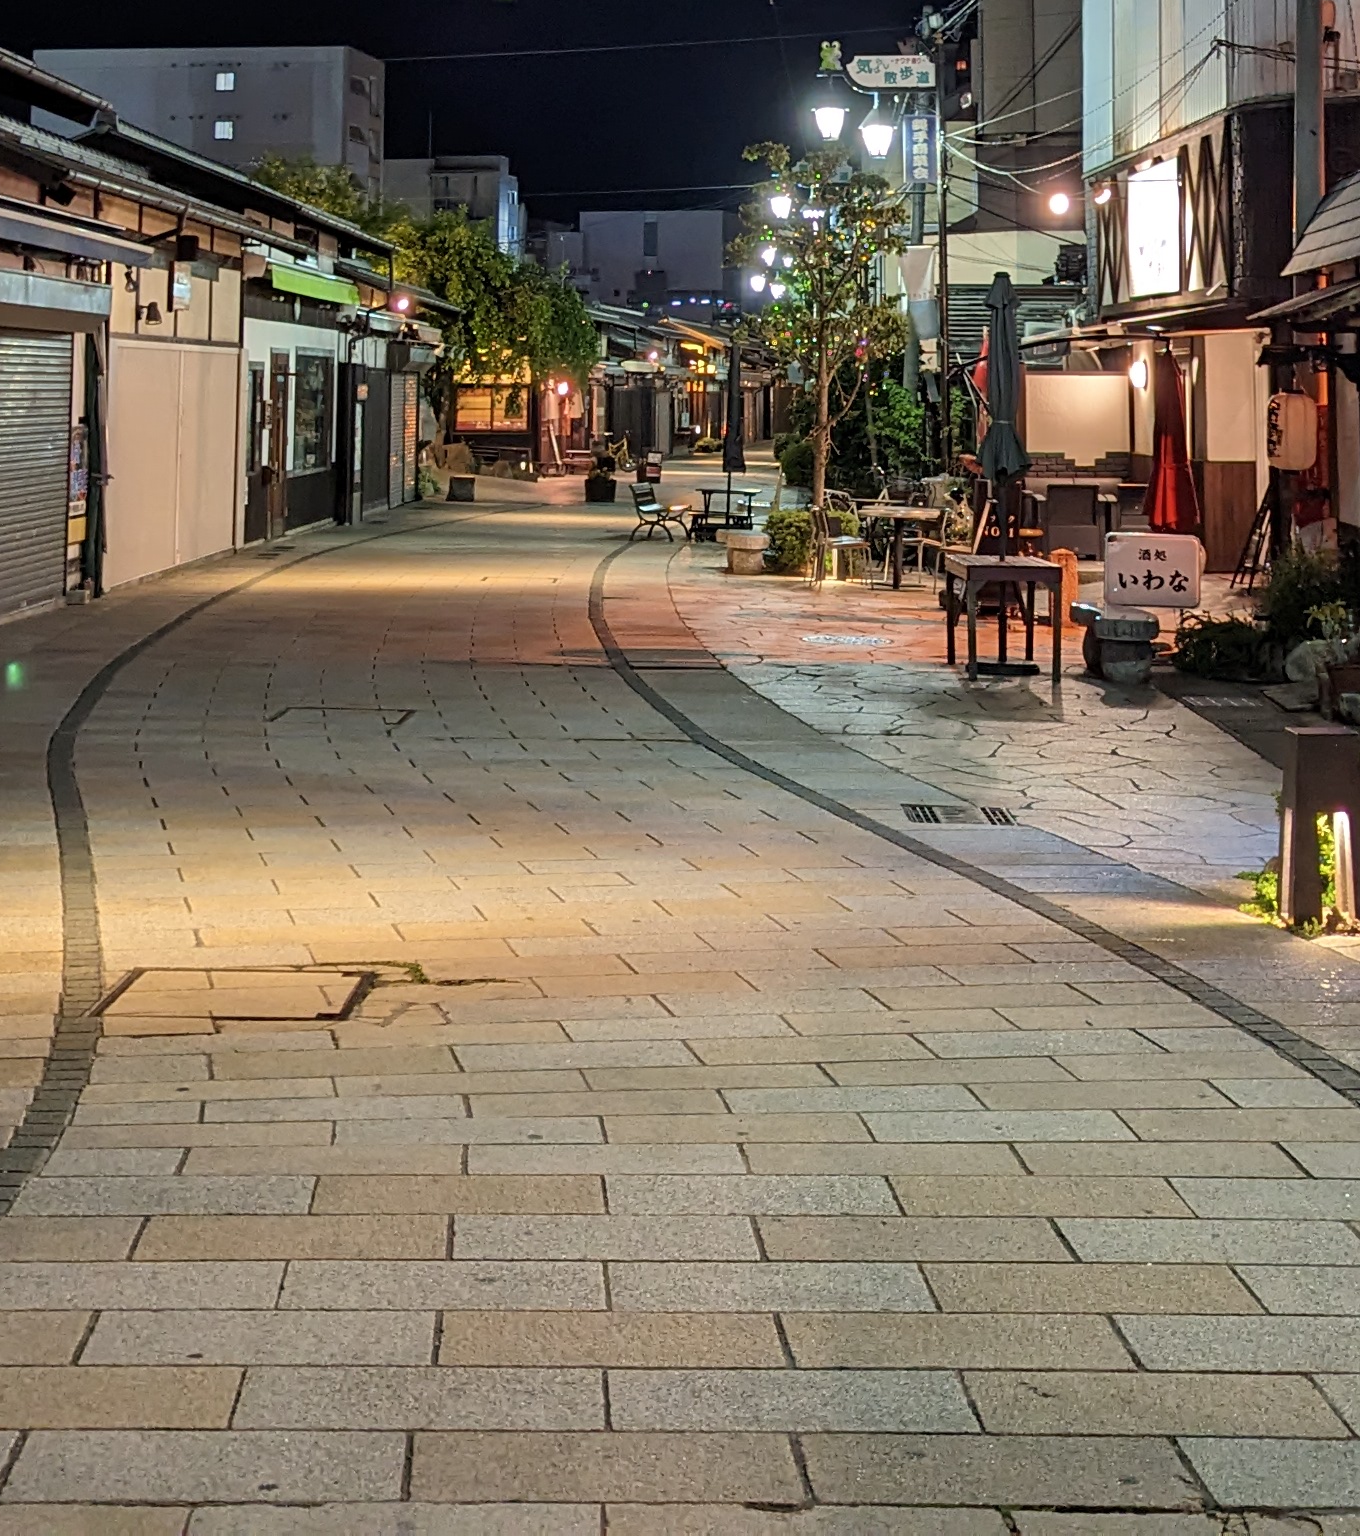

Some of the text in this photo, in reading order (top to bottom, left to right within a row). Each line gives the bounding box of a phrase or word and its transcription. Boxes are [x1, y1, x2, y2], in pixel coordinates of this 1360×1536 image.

[1138, 548, 1168, 562] 酒処
[1117, 569, 1190, 593] いわな
